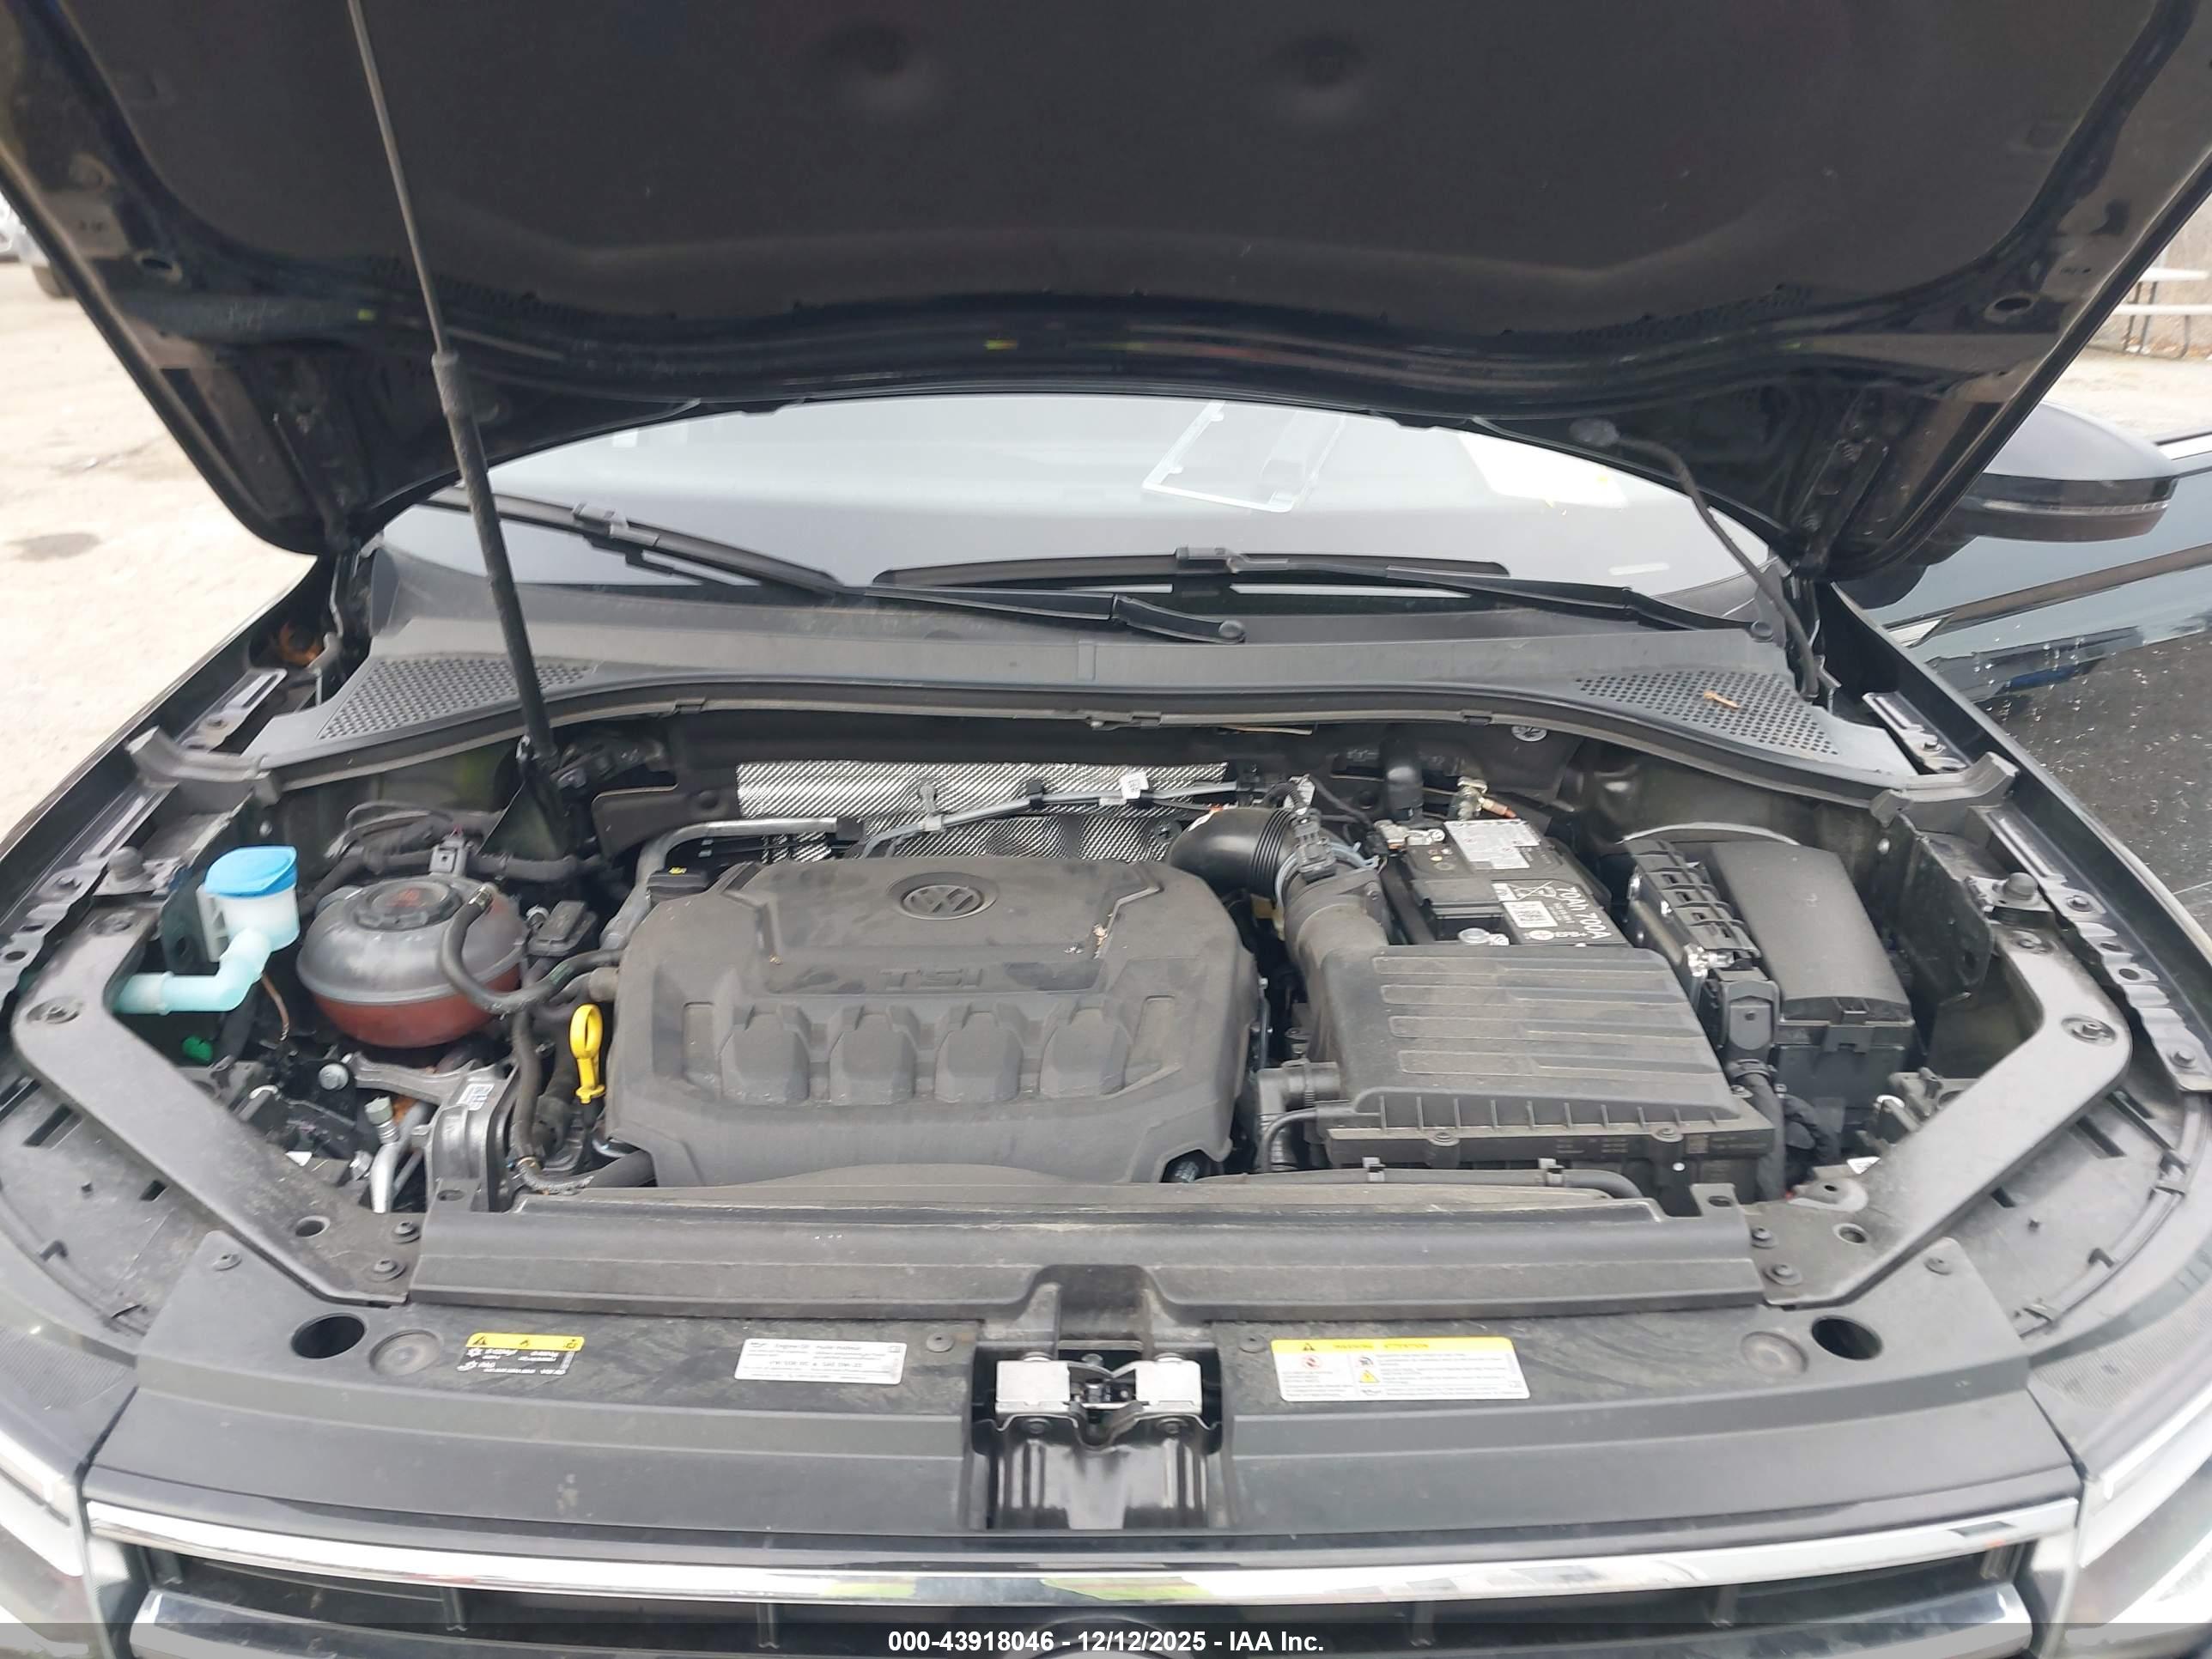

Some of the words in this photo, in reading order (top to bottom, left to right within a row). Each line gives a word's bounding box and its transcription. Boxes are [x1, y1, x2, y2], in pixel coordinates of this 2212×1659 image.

[1556, 886, 1589, 911] 70Ah
[1575, 913, 1612, 939] 700A
[879, 968, 984, 988] TSI
